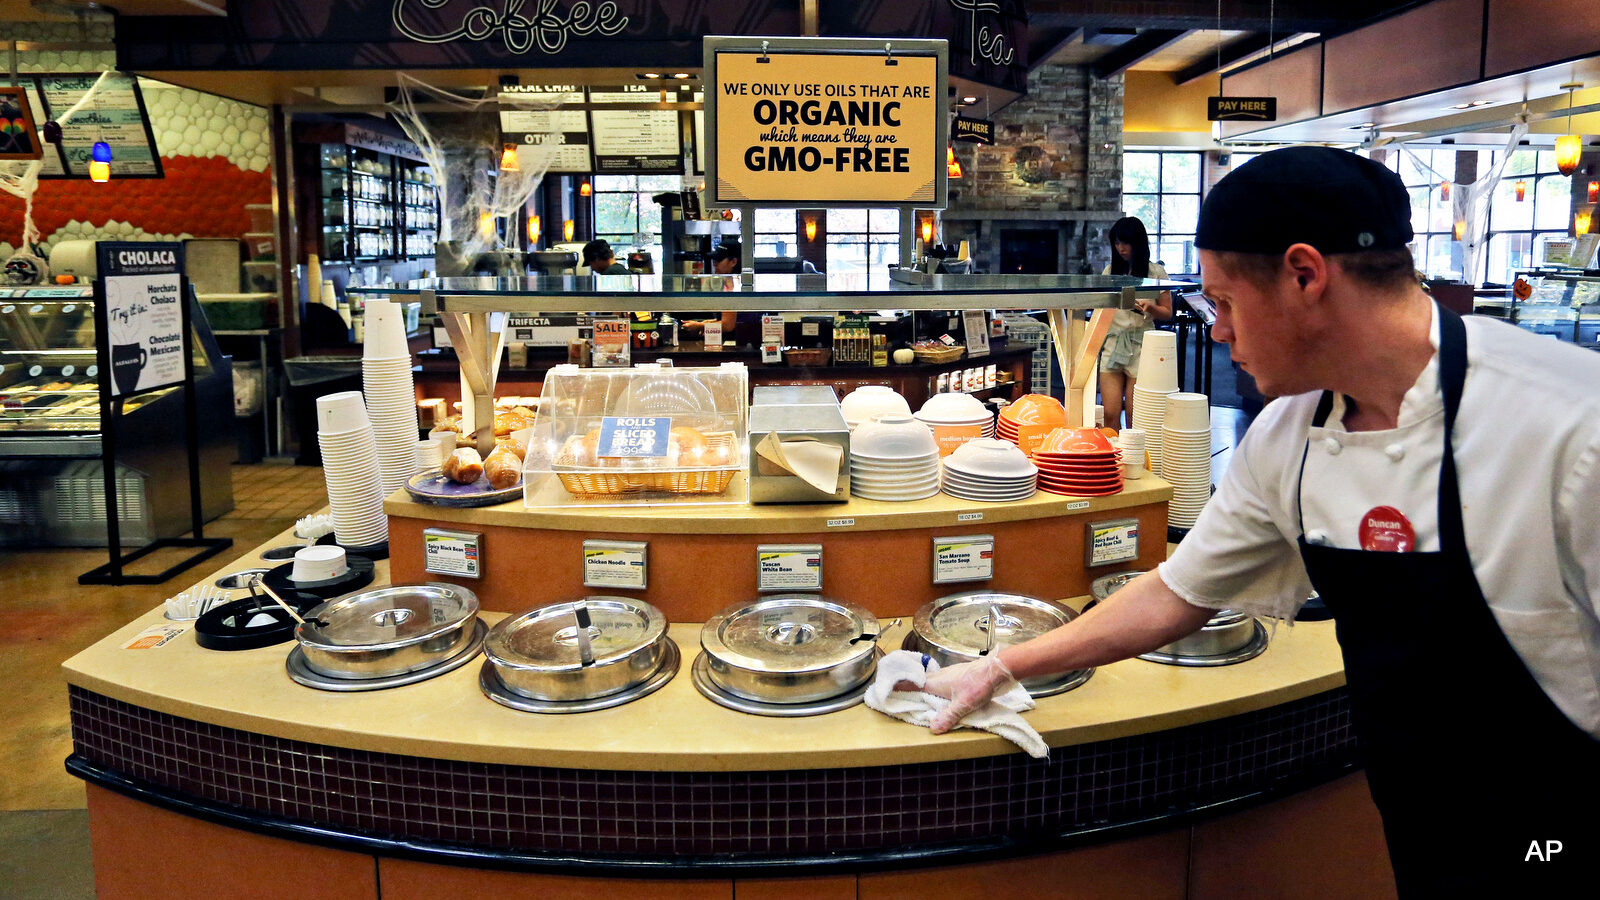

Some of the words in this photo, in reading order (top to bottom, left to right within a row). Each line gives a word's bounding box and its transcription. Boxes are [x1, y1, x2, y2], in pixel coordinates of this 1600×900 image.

[393, 0, 628, 54] Coffee
[950, 0, 1013, 66] Tea
[724, 83, 748, 95] WE
[751, 83, 790, 96] ONLY
[794, 84, 821, 96] USE
[824, 84, 856, 97] OILS
[860, 86, 899, 98] THAT
[902, 88, 930, 99] ARE
[1218, 101, 1238, 111] PAY
[1240, 101, 1267, 111] HERE
[753, 99, 901, 127] ORGANIC
[958, 120, 971, 131] PAY
[972, 123, 989, 134] HERE
[524, 132, 566, 144] OTHR
[760, 126, 798, 143] which
[801, 132, 841, 144] means
[843, 127, 872, 150] they
[875, 133, 897, 144] are
[744, 145, 910, 172] GMO-FREE
[119, 250, 176, 266] CHOLACA
[148, 284, 177, 294] Horchata
[150, 296, 176, 305] Cholaca
[110, 308, 129, 324] Try
[510, 318, 551, 326] TRIFECTA
[595, 322, 627, 335] SALE!
[616, 418, 656, 427] ROLLS
[613, 429, 657, 438] SLICED
[612, 438, 656, 447] BREAD
[1367, 518, 1401, 530] Duncan
